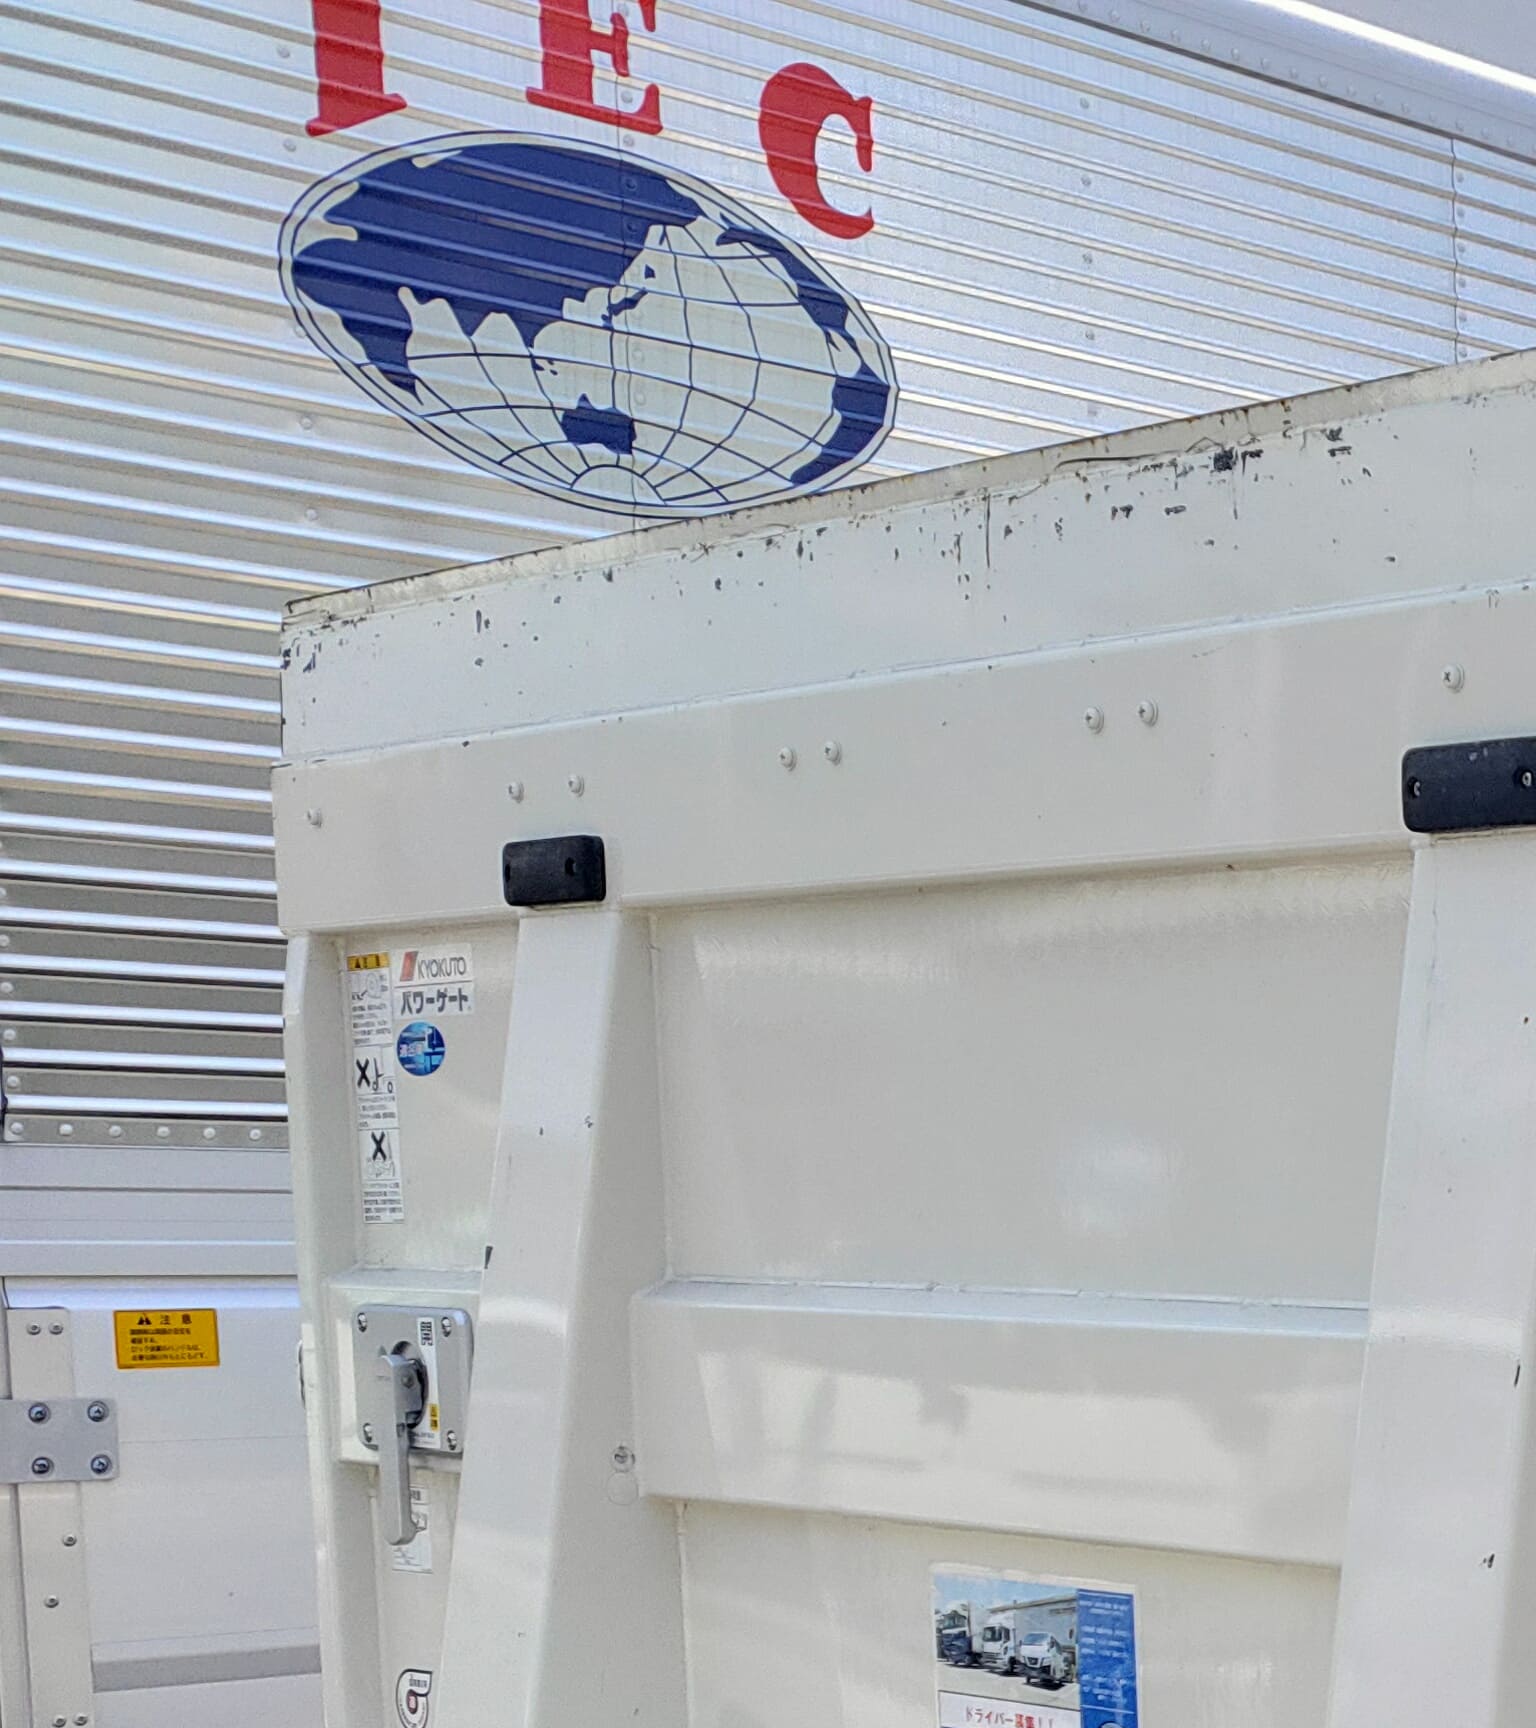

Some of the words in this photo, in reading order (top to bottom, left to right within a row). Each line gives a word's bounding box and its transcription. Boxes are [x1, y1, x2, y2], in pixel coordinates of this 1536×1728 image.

[417, 956, 467, 978] KYOKUTO
[400, 988, 470, 1016] パワーゲート
